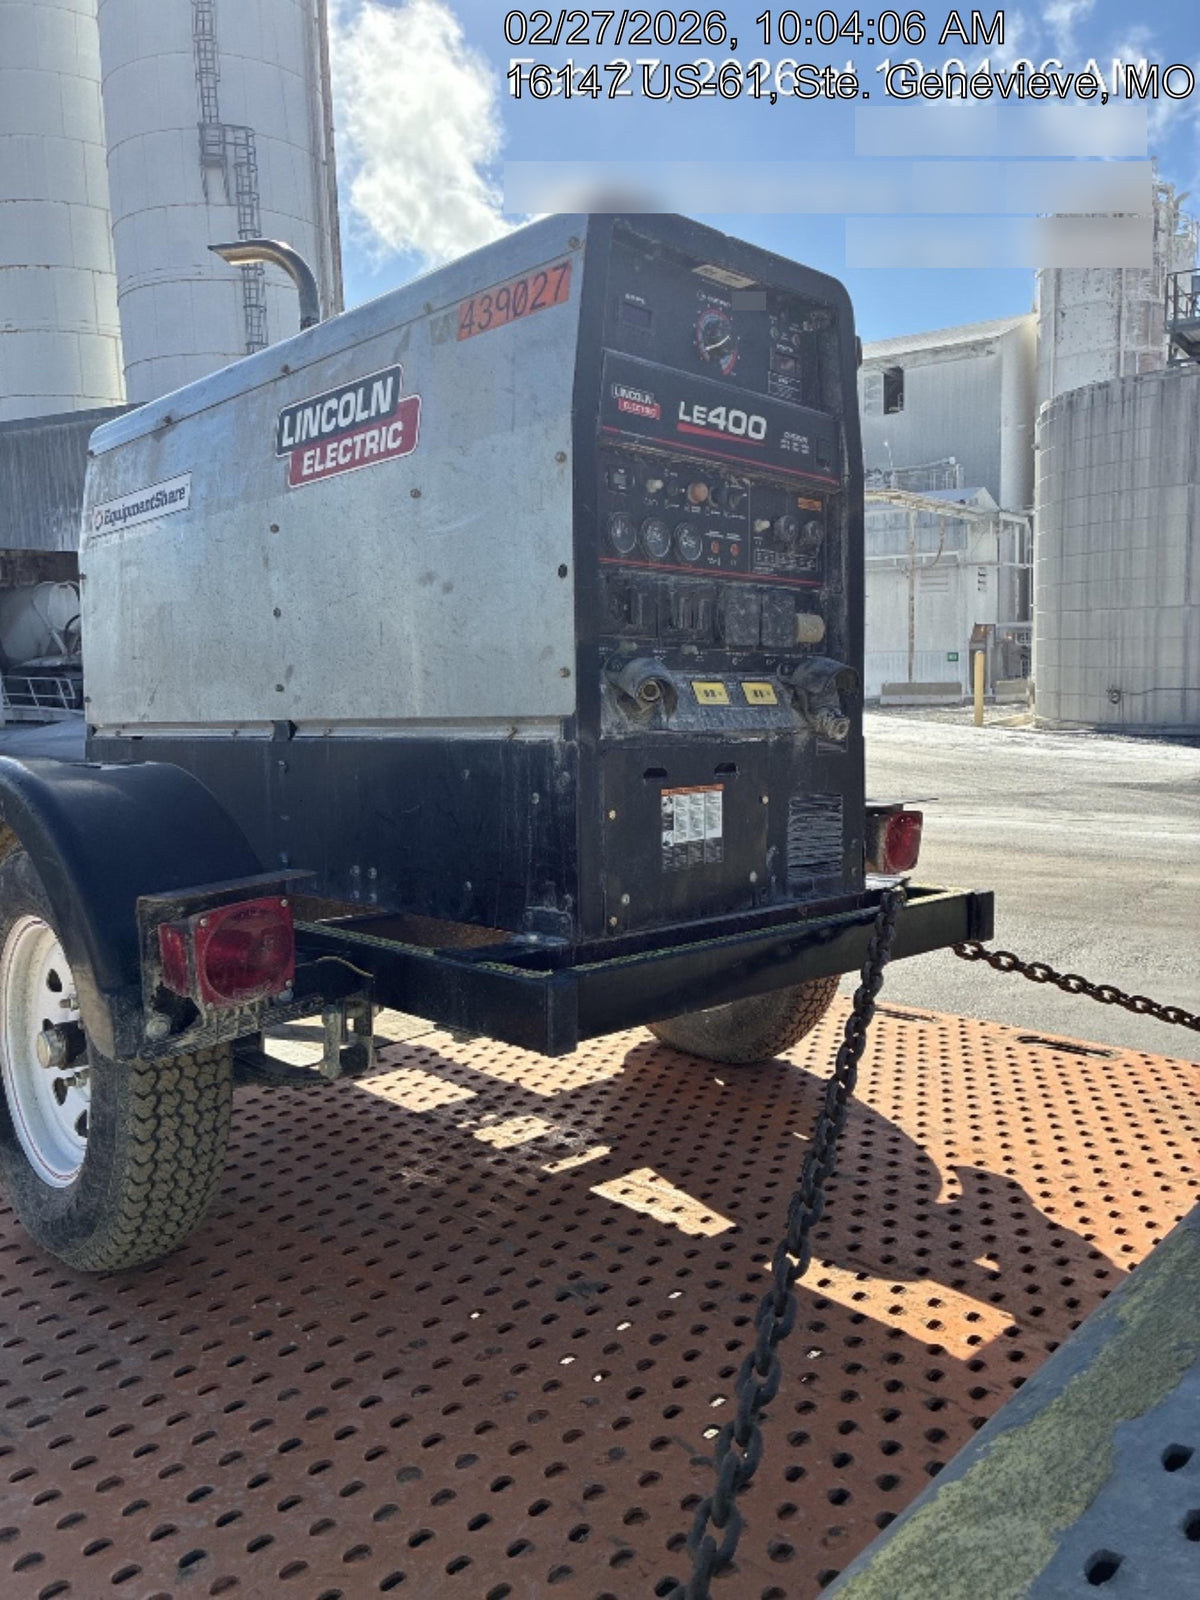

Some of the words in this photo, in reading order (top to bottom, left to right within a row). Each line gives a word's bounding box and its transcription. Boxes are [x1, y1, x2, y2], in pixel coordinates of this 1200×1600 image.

[460, 262, 571, 334] 439027
[281, 376, 395, 448] LINCOLN
[678, 401, 768, 441] LE400
[301, 420, 404, 477] ELECTRIC
[104, 485, 186, 527] EquipmentShare
